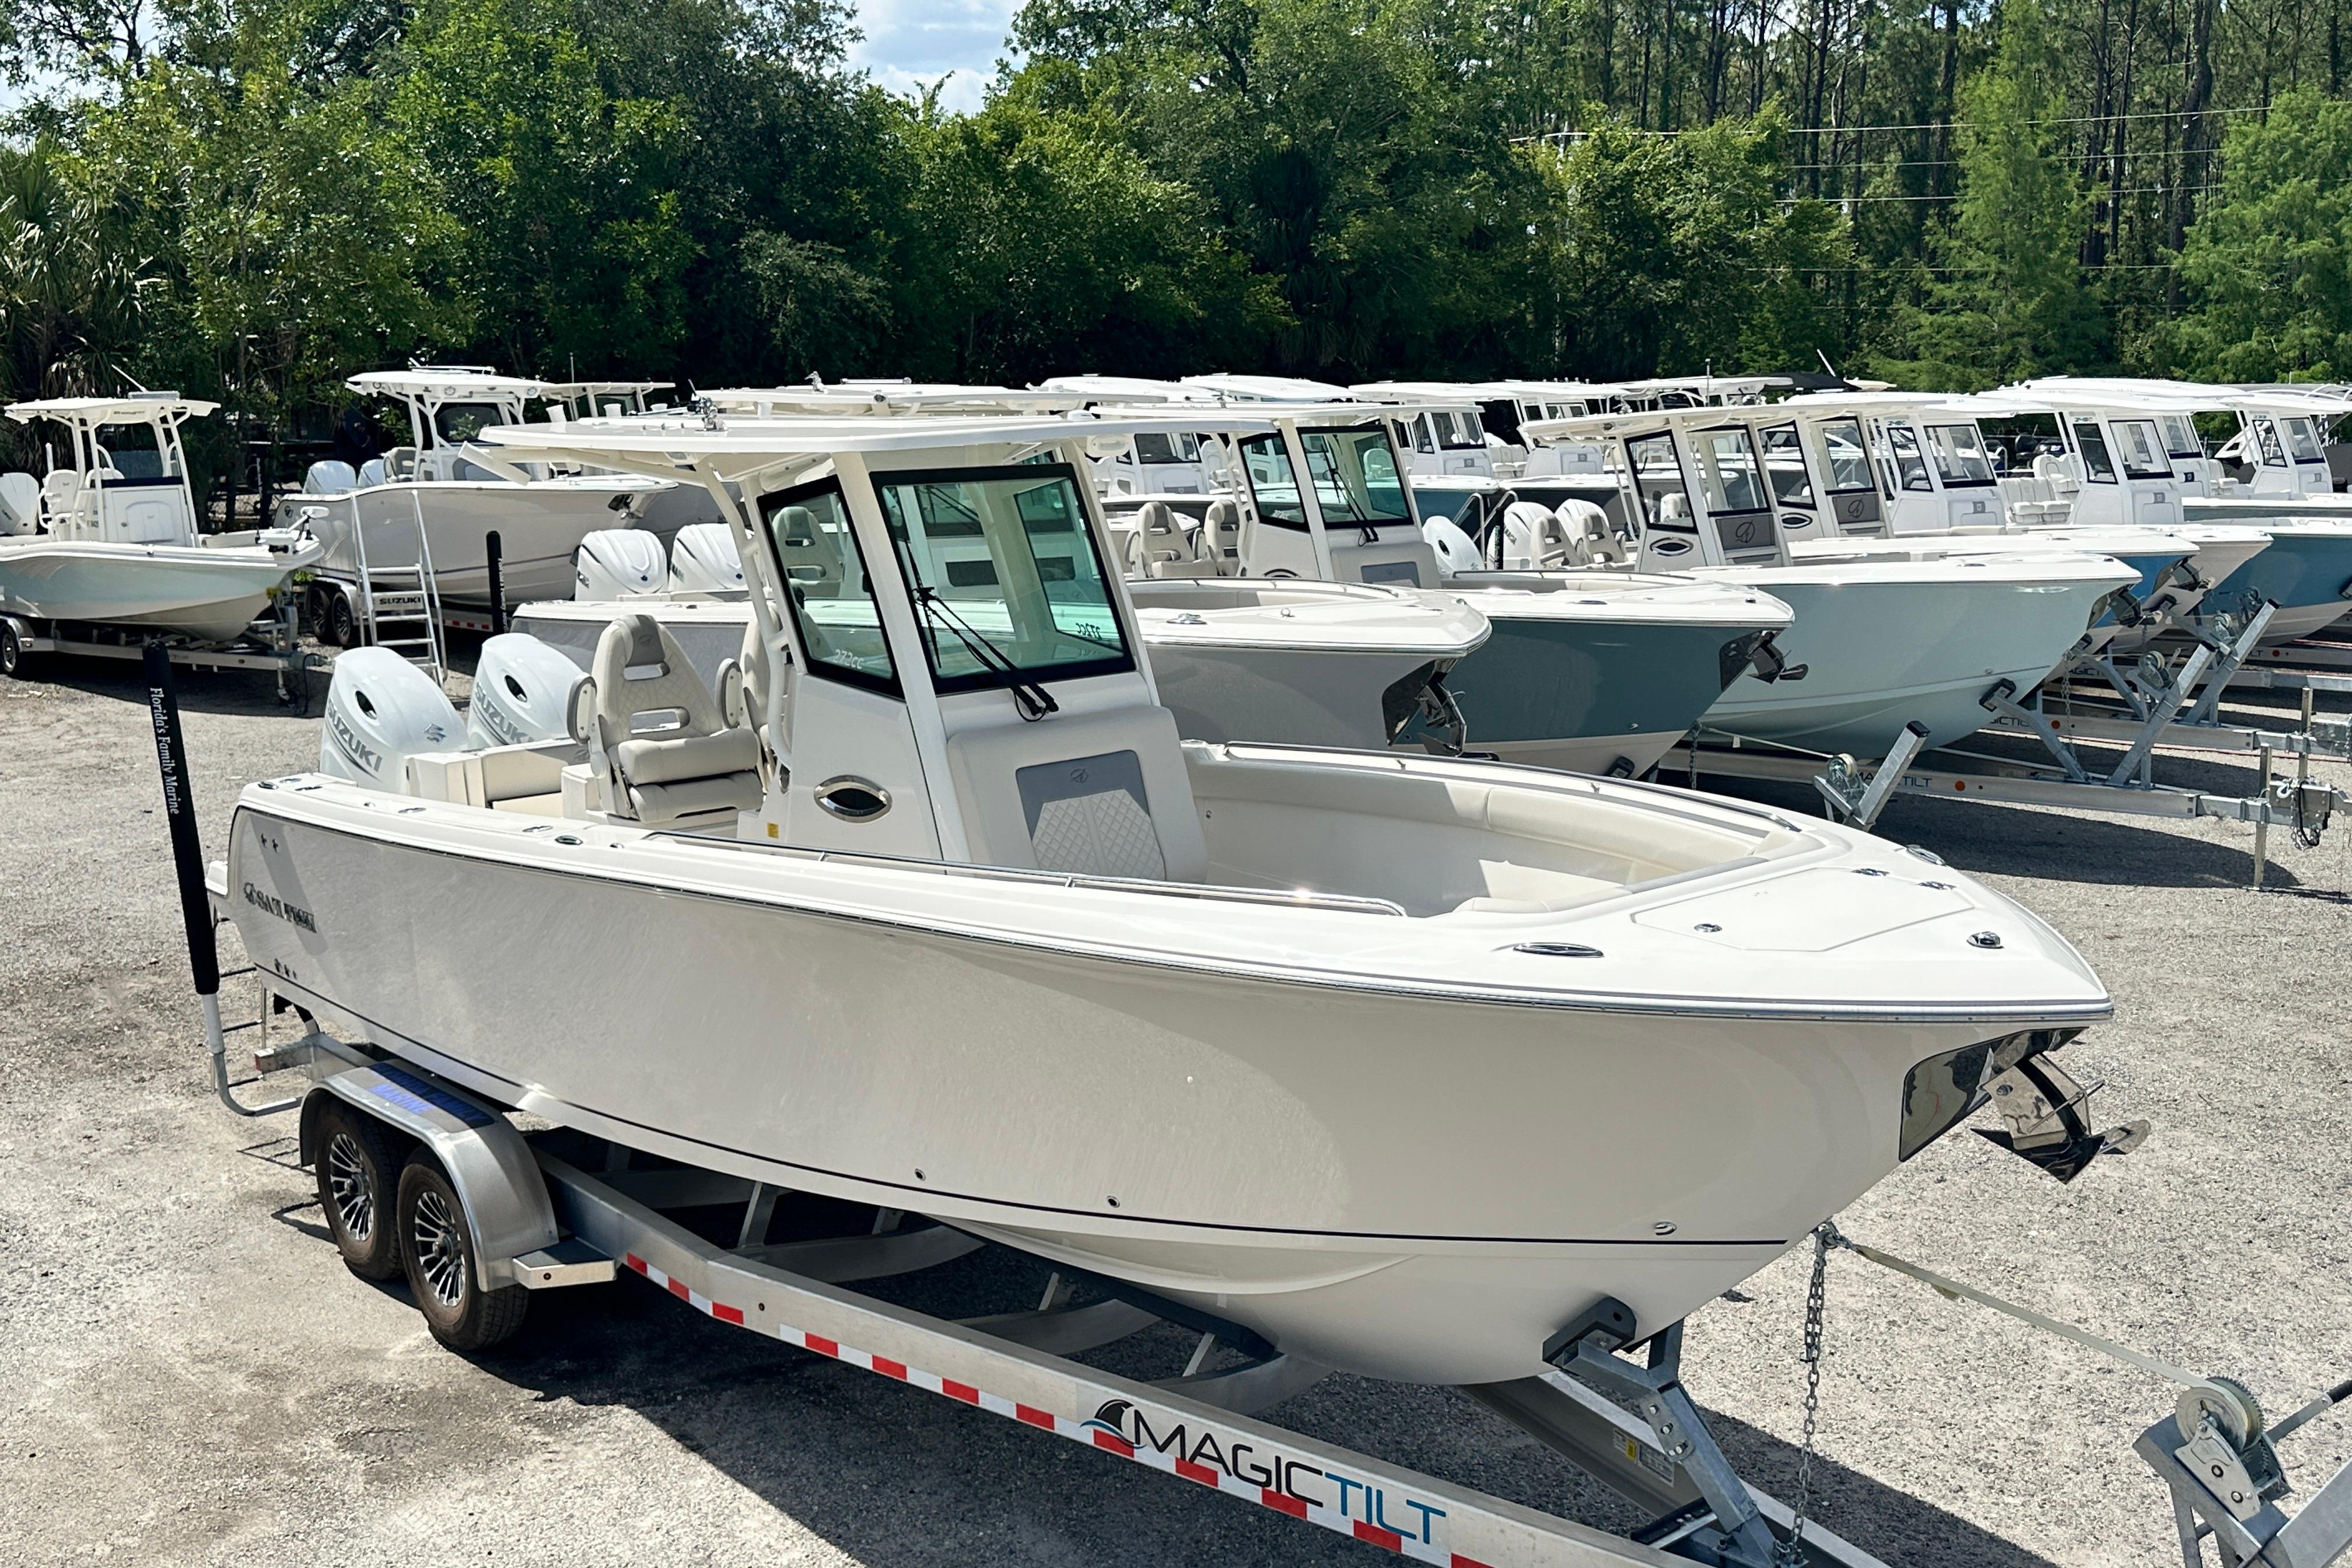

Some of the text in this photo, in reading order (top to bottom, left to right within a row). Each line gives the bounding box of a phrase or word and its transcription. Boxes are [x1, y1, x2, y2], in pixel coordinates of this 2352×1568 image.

[379, 596, 421, 605] SUZUKI
[2248, 649, 2264, 657] LT
[149, 687, 182, 815] Florida's Family Marine
[327, 697, 383, 772] SUZUKI
[1898, 775, 1933, 788] TILT
[1134, 1409, 1447, 1545] MAGICTILT
